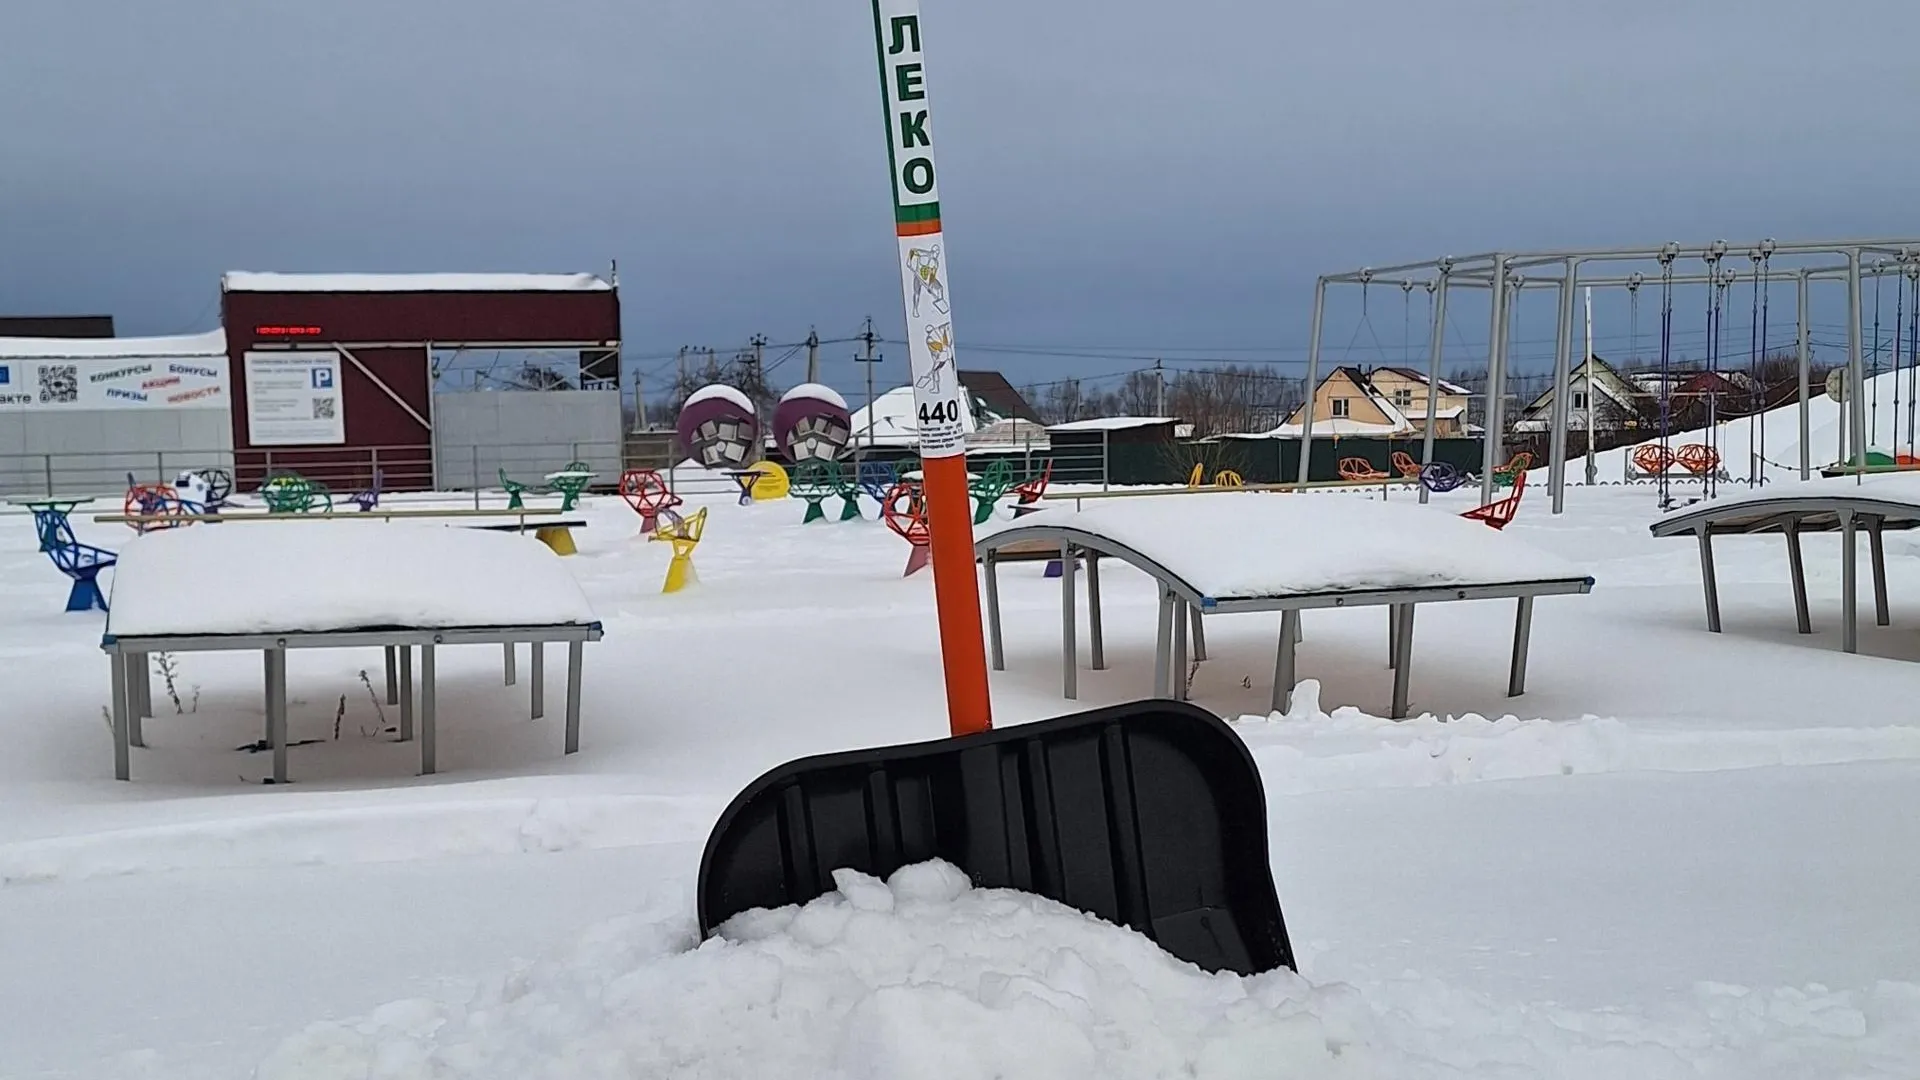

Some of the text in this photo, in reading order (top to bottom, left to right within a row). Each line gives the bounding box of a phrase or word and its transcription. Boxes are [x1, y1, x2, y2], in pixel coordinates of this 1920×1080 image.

[888, 15, 934, 194] ЛЕКО
[90, 364, 152, 383] КОНКУРСЫ
[169, 364, 217, 377] БОНУСЫ
[107, 388, 148, 401] ПРИЗЫ
[167, 386, 220, 402] НОВОСТИ
[918, 399, 958, 424] 440
